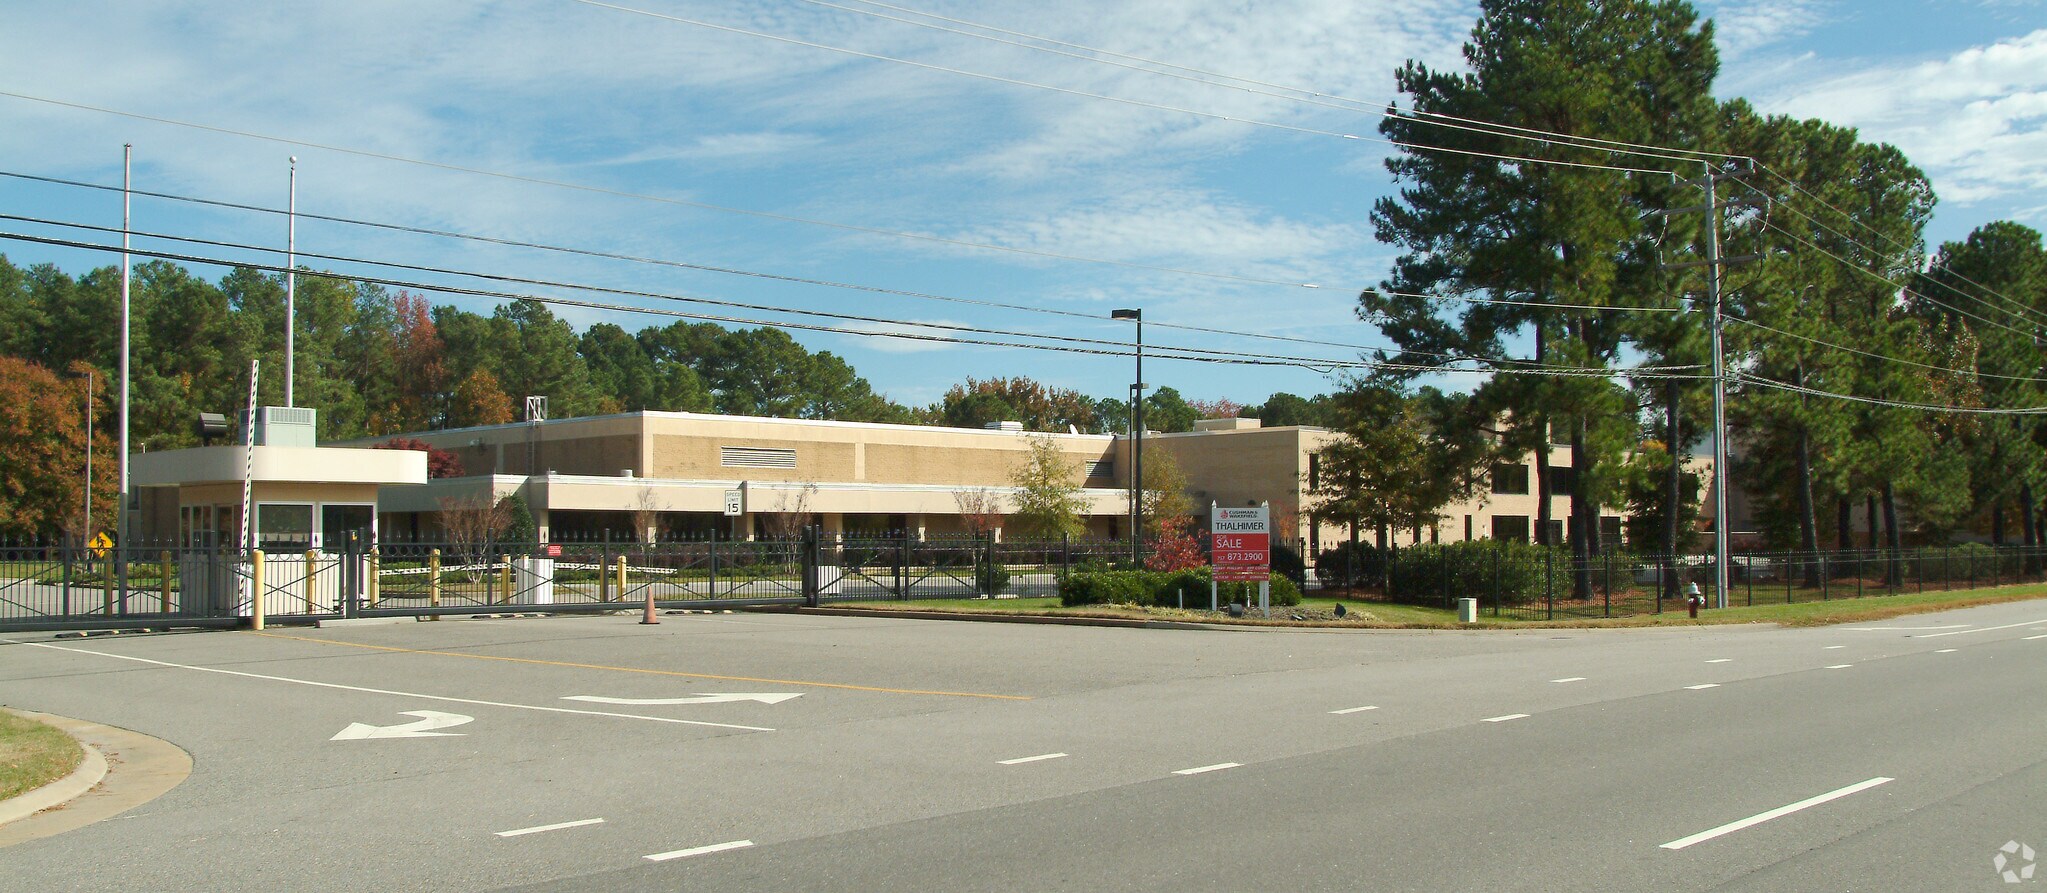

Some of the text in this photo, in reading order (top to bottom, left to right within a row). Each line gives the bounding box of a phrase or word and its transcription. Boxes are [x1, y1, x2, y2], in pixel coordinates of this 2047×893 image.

[728, 504, 739, 512] 15
[1216, 522, 1264, 530] THALHIMER
[1216, 539, 1242, 548] SALE
